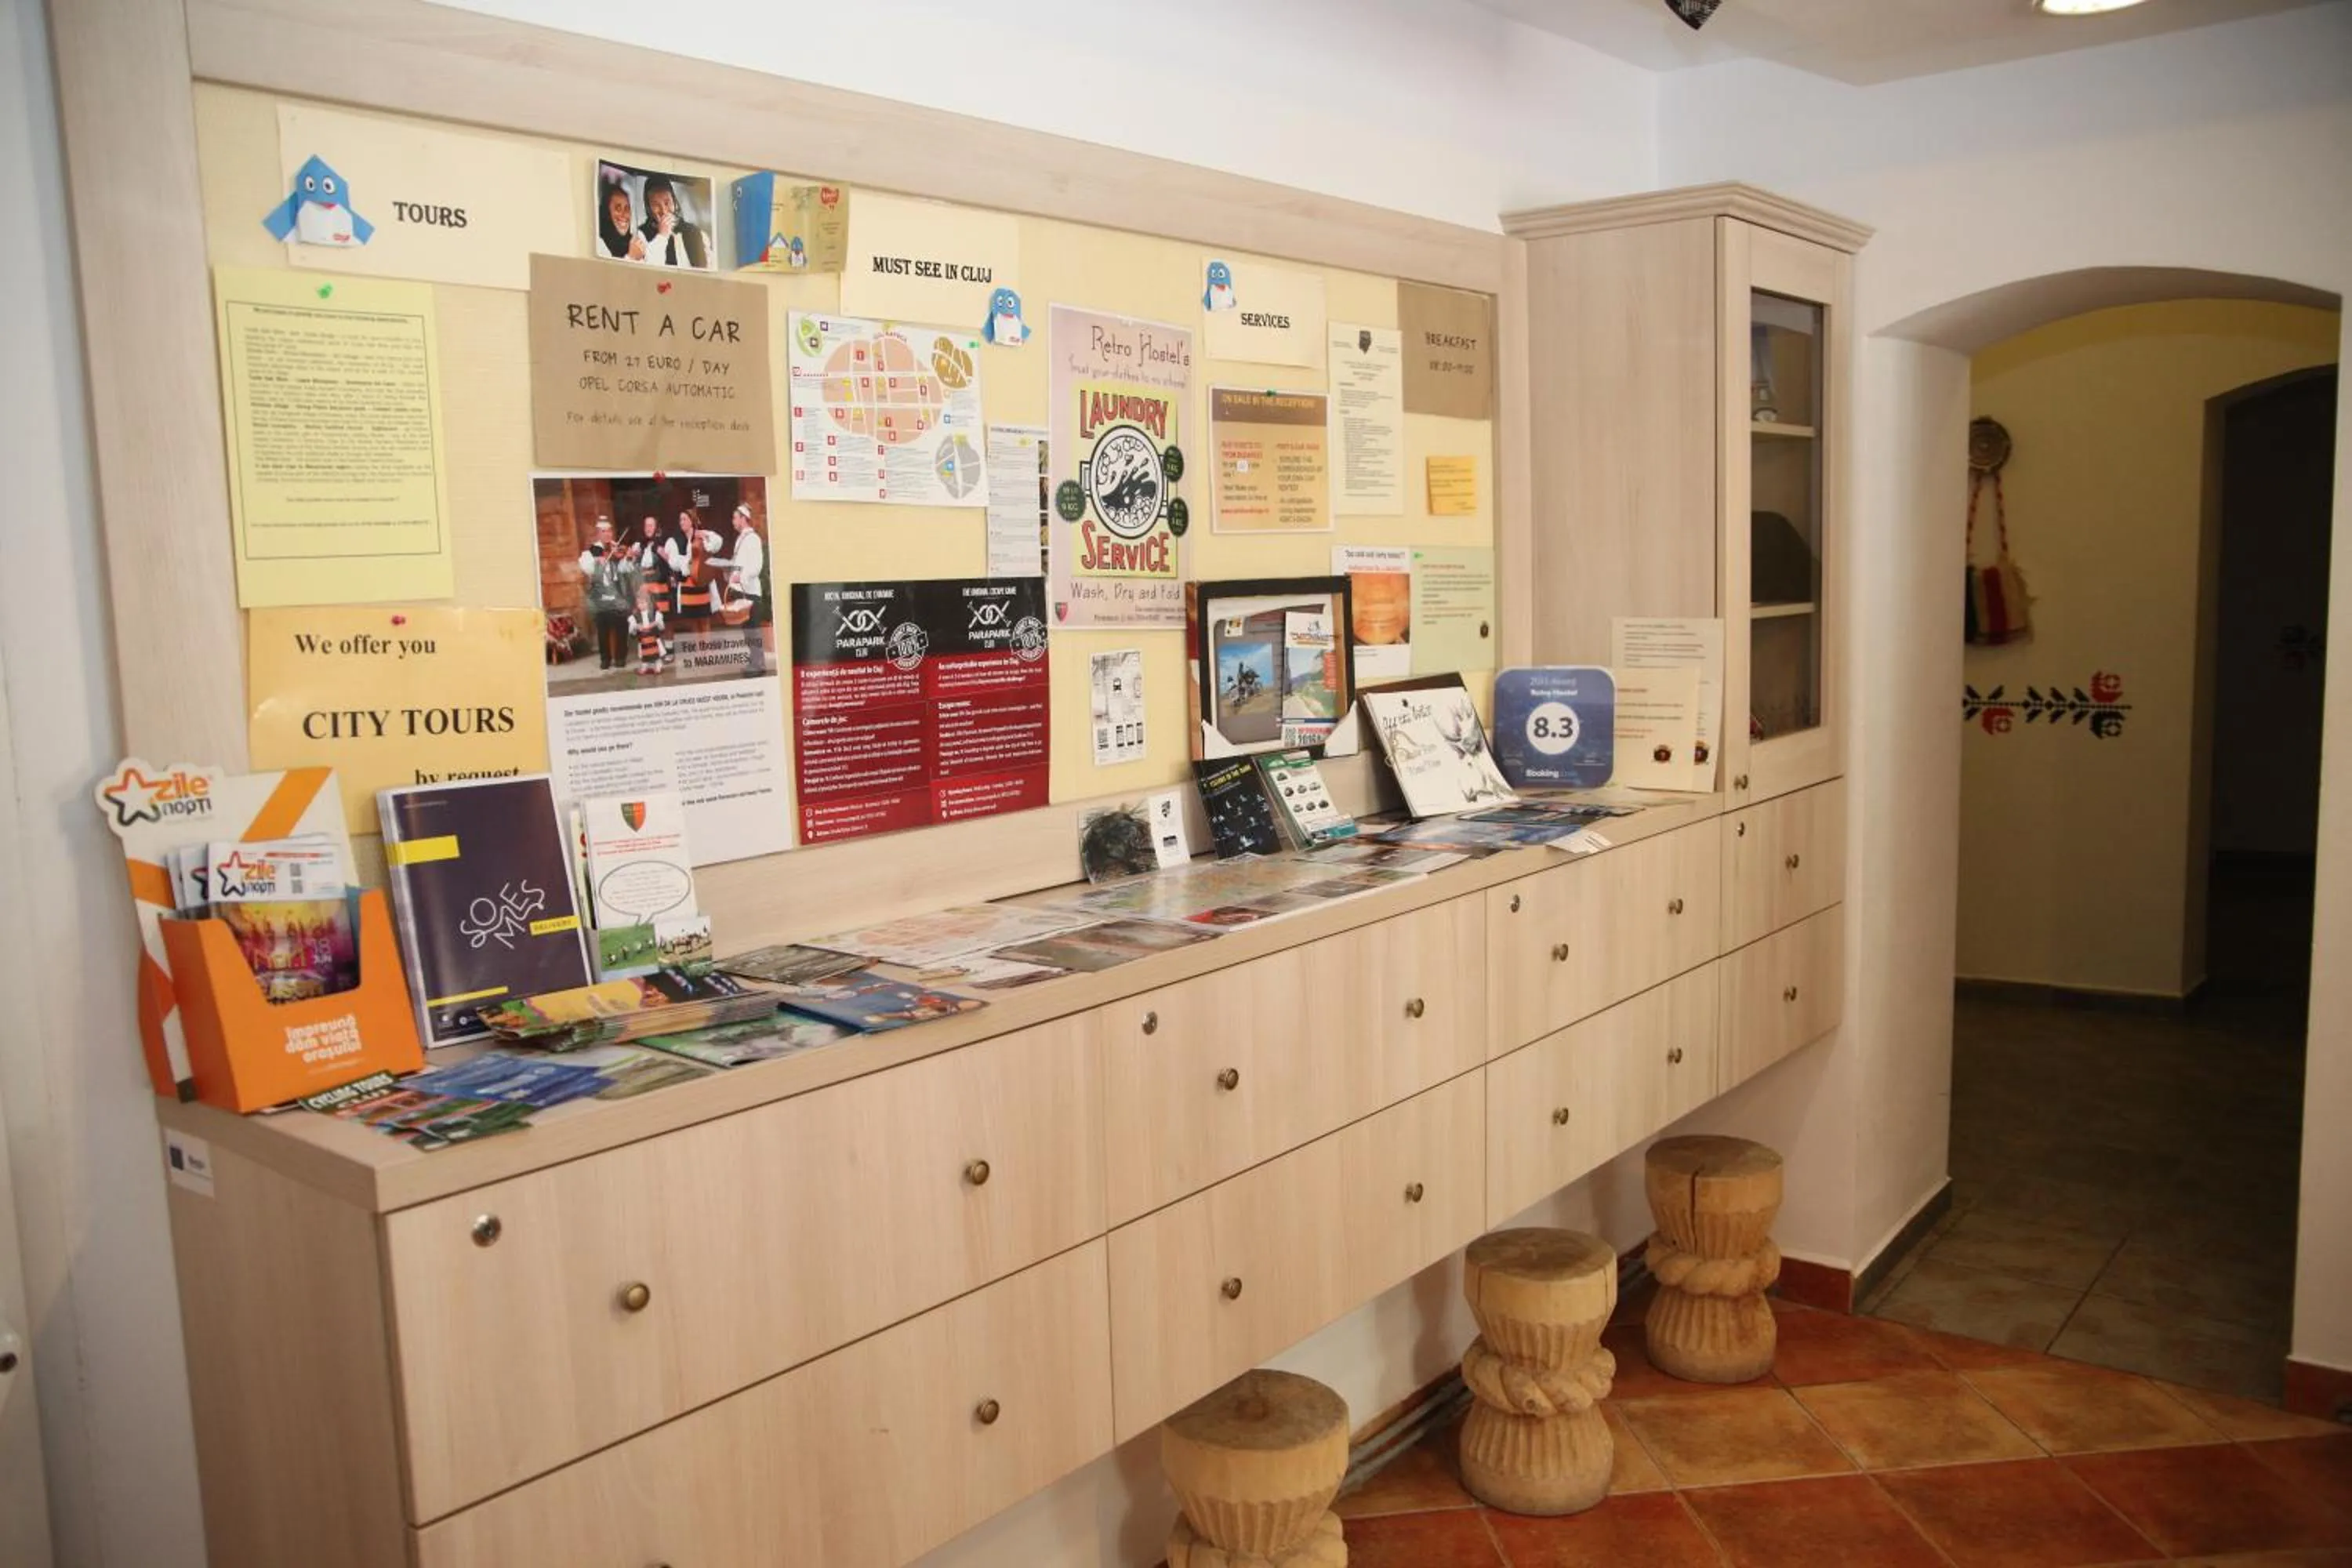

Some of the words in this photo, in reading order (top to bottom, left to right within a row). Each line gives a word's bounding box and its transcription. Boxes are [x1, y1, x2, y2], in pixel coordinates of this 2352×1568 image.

[393, 200, 468, 229] TOURS
[873, 256, 912, 275] MUST
[915, 261, 941, 278] SEE
[945, 263, 958, 280] IN
[960, 266, 992, 283] CLUJ
[567, 303, 640, 335] RENT
[659, 314, 675, 337] A
[692, 316, 740, 343] CAR
[1240, 313, 1290, 329] SERVICES
[1091, 325, 1132, 361] Retro
[1138, 332, 1189, 367] Hostel's
[1425, 331, 1477, 350] BREAKFAST
[583, 350, 618, 365] FROM
[648, 355, 681, 371] EURO
[702, 361, 730, 376] DAY
[579, 376, 609, 391] OPEL
[618, 378, 659, 394] CORSA
[666, 381, 735, 399] AUTOMATIC
[1080, 389, 1168, 440] LAUNDRY
[1081, 520, 1171, 572] SERVICE
[1071, 583, 1109, 601] Wash,
[1115, 583, 1134, 601] Dry
[1138, 585, 1156, 600] and
[294, 633, 332, 655] We
[339, 633, 393, 655] offer
[398, 637, 437, 659] you
[681, 640, 697, 652] For
[698, 639, 722, 652] those
[836, 636, 886, 648] PARAPARK
[968, 630, 1011, 640] PARAPARK
[683, 658, 692, 669] to
[302, 710, 391, 739] CITY
[401, 706, 515, 735] TOURS
[1534, 716, 1573, 738] 8.3
[155, 771, 209, 800] zile
[415, 768, 440, 786] by
